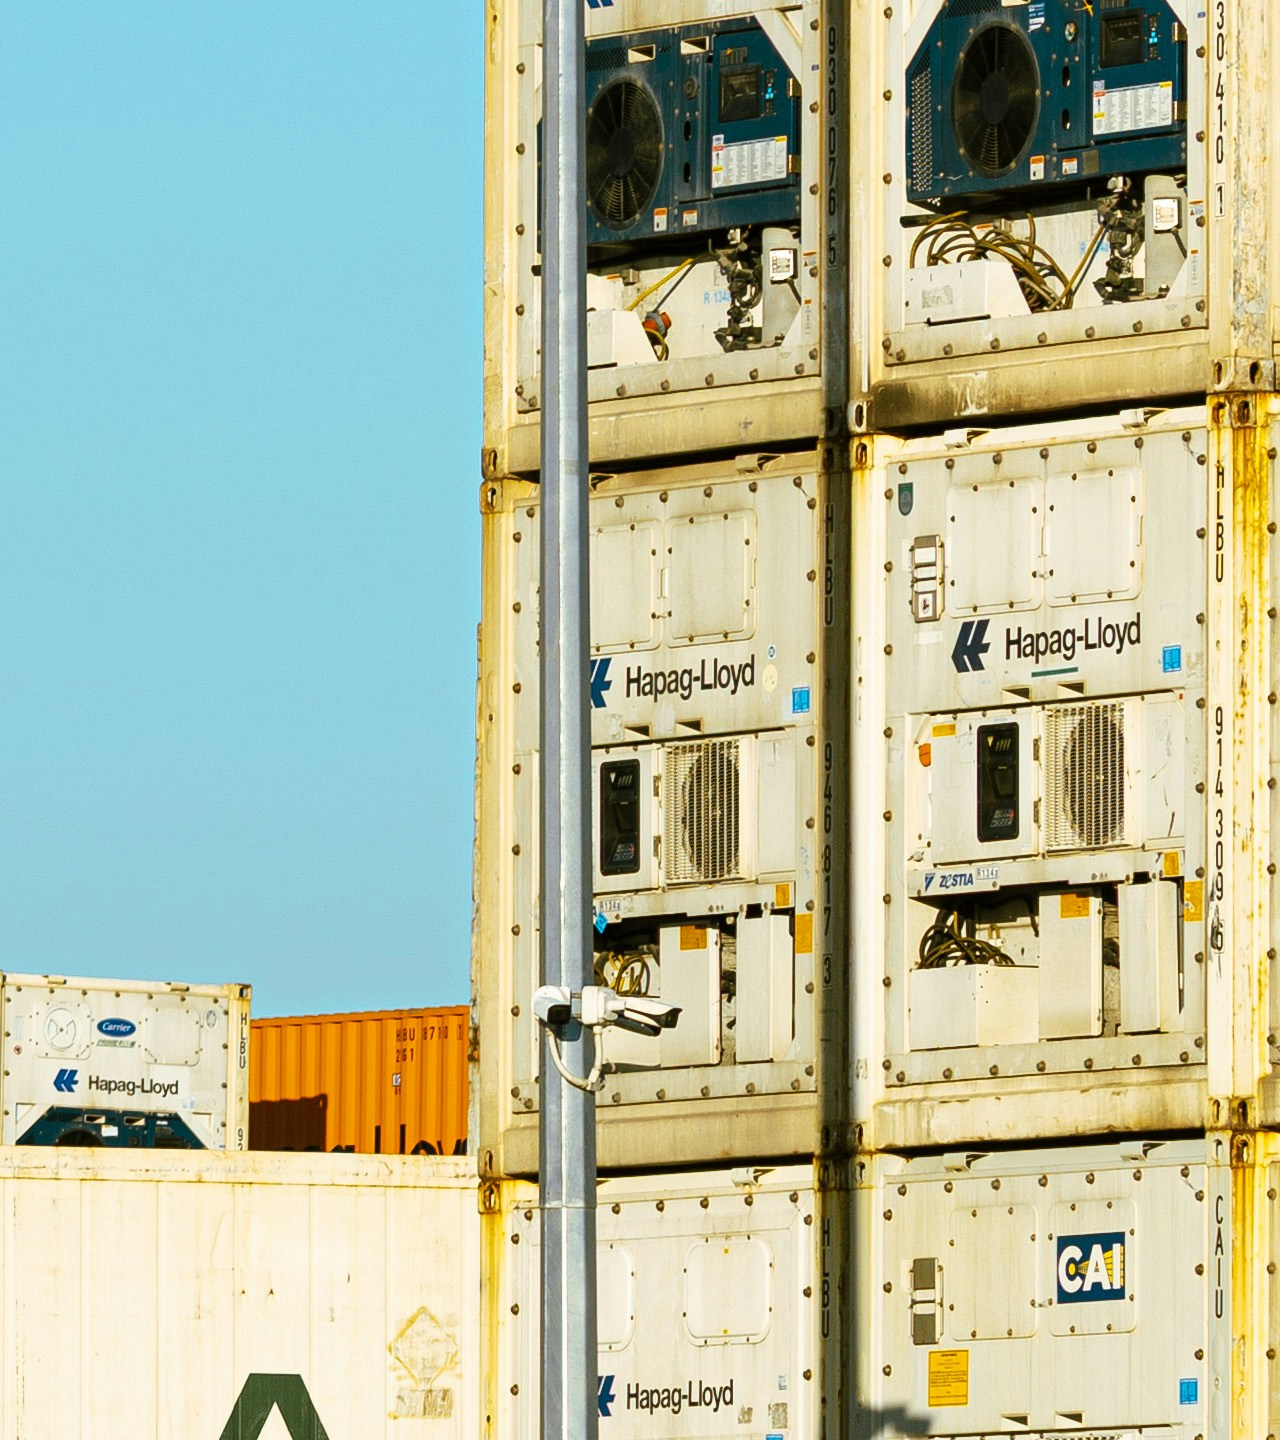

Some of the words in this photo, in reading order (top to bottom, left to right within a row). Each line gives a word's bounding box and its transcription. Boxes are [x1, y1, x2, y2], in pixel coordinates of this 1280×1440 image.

[1214, 71, 1226, 166] 410
[1215, 463, 1225, 583] HLBU
[1004, 613, 1141, 663] Hapag-Lloyd
[625, 654, 756, 702] Hapag-Lloyd
[1214, 706, 1224, 799] 914
[1214, 809, 1225, 902] 309
[103, 1021, 132, 1035] Carrier
[240, 1013, 248, 1069] HLBU
[88, 1075, 179, 1097] Hapag-Lloyd
[1057, 1244, 1124, 1294] CAI
[1215, 1195, 1225, 1320] CAIU
[625, 1379, 734, 1415] Hapag-Lloyd
